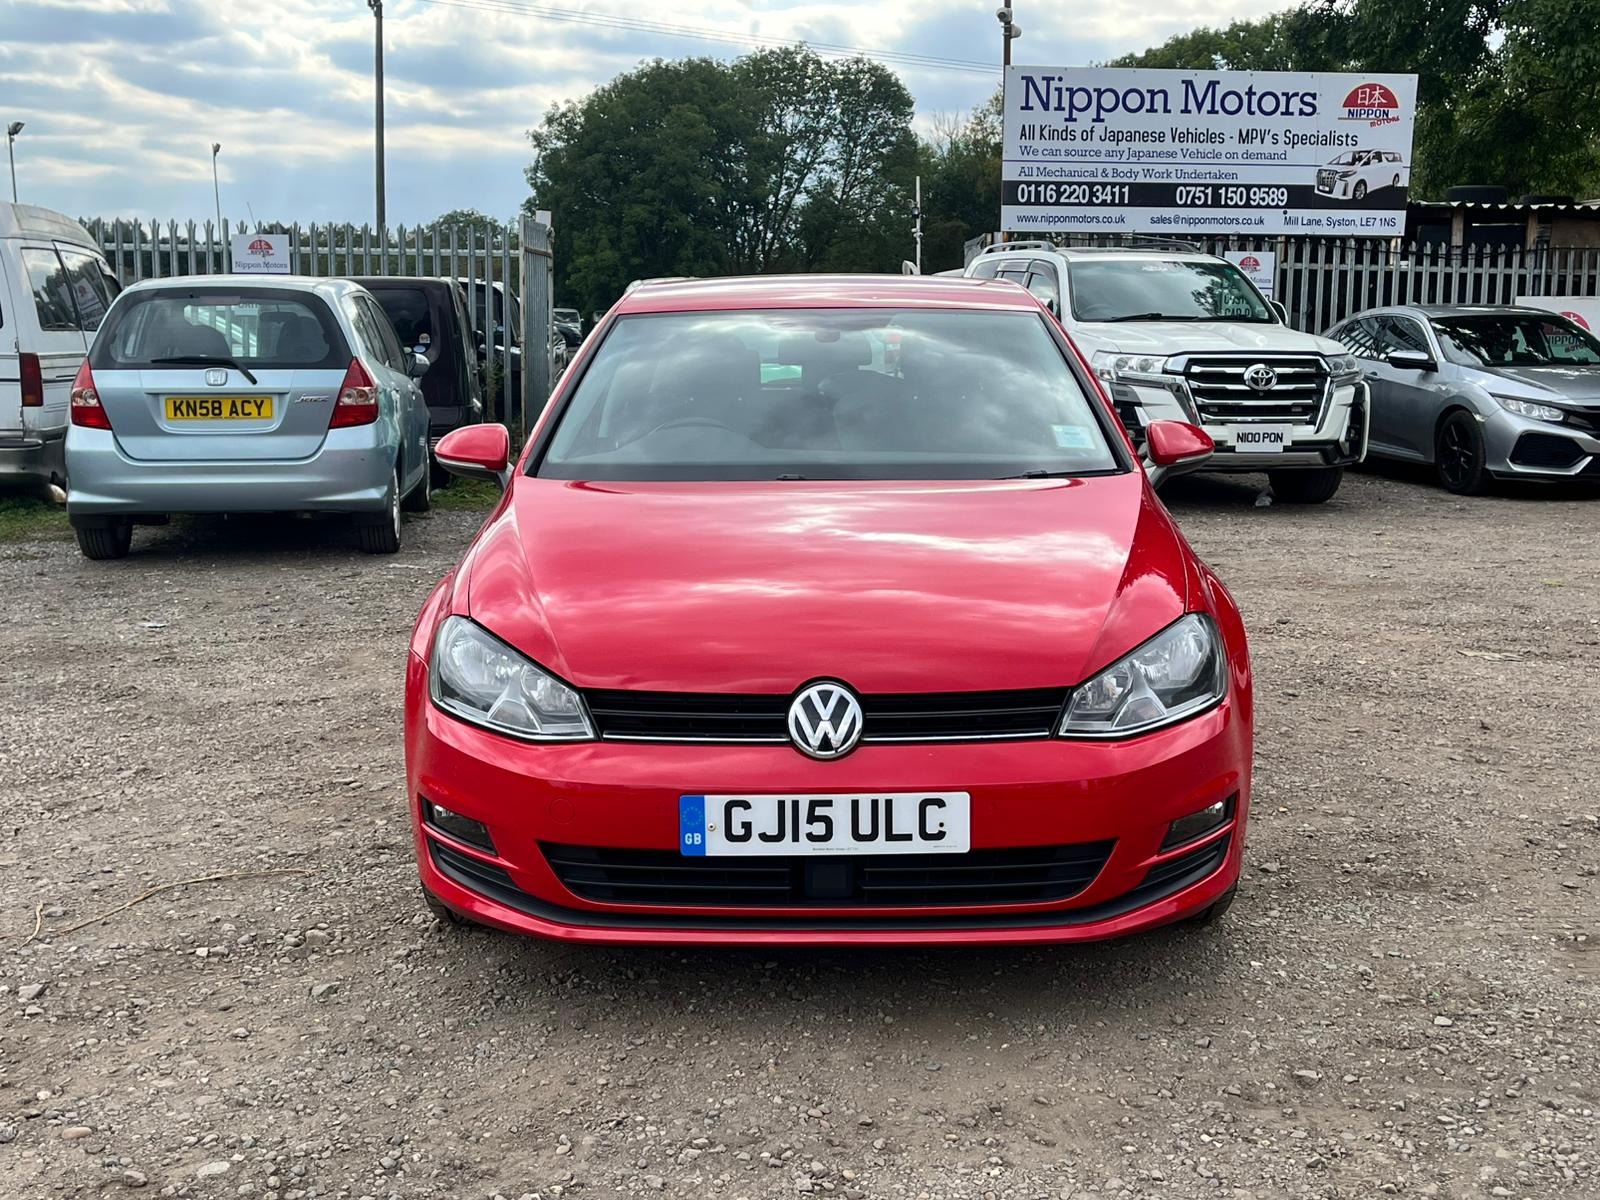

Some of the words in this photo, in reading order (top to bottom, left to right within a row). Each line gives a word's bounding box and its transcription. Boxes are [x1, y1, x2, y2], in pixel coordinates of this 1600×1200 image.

[1020, 75, 1171, 123] Nippon
[1180, 79, 1317, 116] Motors
[1357, 85, 1387, 107] 日本
[1347, 108, 1389, 118] NIPPON
[1020, 124, 1035, 141] All
[1040, 125, 1076, 141] Kinds
[1081, 126, 1095, 141] of
[1100, 126, 1166, 147] Japanese
[1171, 127, 1225, 144] Vehicles
[1238, 128, 1279, 145] MPV's
[1283, 129, 1359, 149] Specialists
[1019, 146, 1039, 157] We
[1041, 148, 1062, 157] can
[1064, 148, 1101, 158] source
[1104, 149, 1125, 160] any
[1127, 148, 1177, 160] Japanese
[1180, 148, 1222, 159] Vehicle
[1225, 151, 1239, 159] on
[1241, 150, 1287, 160] demand
[1018, 167, 1033, 177] All
[1036, 167, 1098, 178] Mechanical
[1101, 168, 1109, 178] &
[1111, 168, 1139, 181] Body
[1142, 168, 1172, 179] Work
[1175, 169, 1238, 180] Undertaken
[1017, 184, 1057, 203] 0116
[1060, 185, 1089, 203] 220
[1092, 185, 1129, 204] 3411
[1176, 186, 1213, 205] 0751
[1218, 187, 1247, 205] 150
[1250, 187, 1288, 206] 9589
[1017, 213, 1125, 226] www.nipponmotors.co.uk
[1150, 215, 1264, 227] sales@nipponmotors.co.uk
[1284, 216, 1298, 226] Mill
[1301, 217, 1324, 228] Lane,
[1326, 217, 1358, 228] Syston,
[1360, 218, 1377, 227] LE7
[1380, 218, 1397, 227] 1NS
[235, 261, 261, 269] Nippon
[263, 261, 288, 269] Motors
[173, 400, 222, 417] KN58
[229, 399, 265, 417] ACY
[1262, 432, 1284, 443] PON
[788, 684, 862, 758] VW
[724, 798, 834, 843] GJ15
[851, 797, 947, 842] ULC
[685, 833, 702, 845] GB
